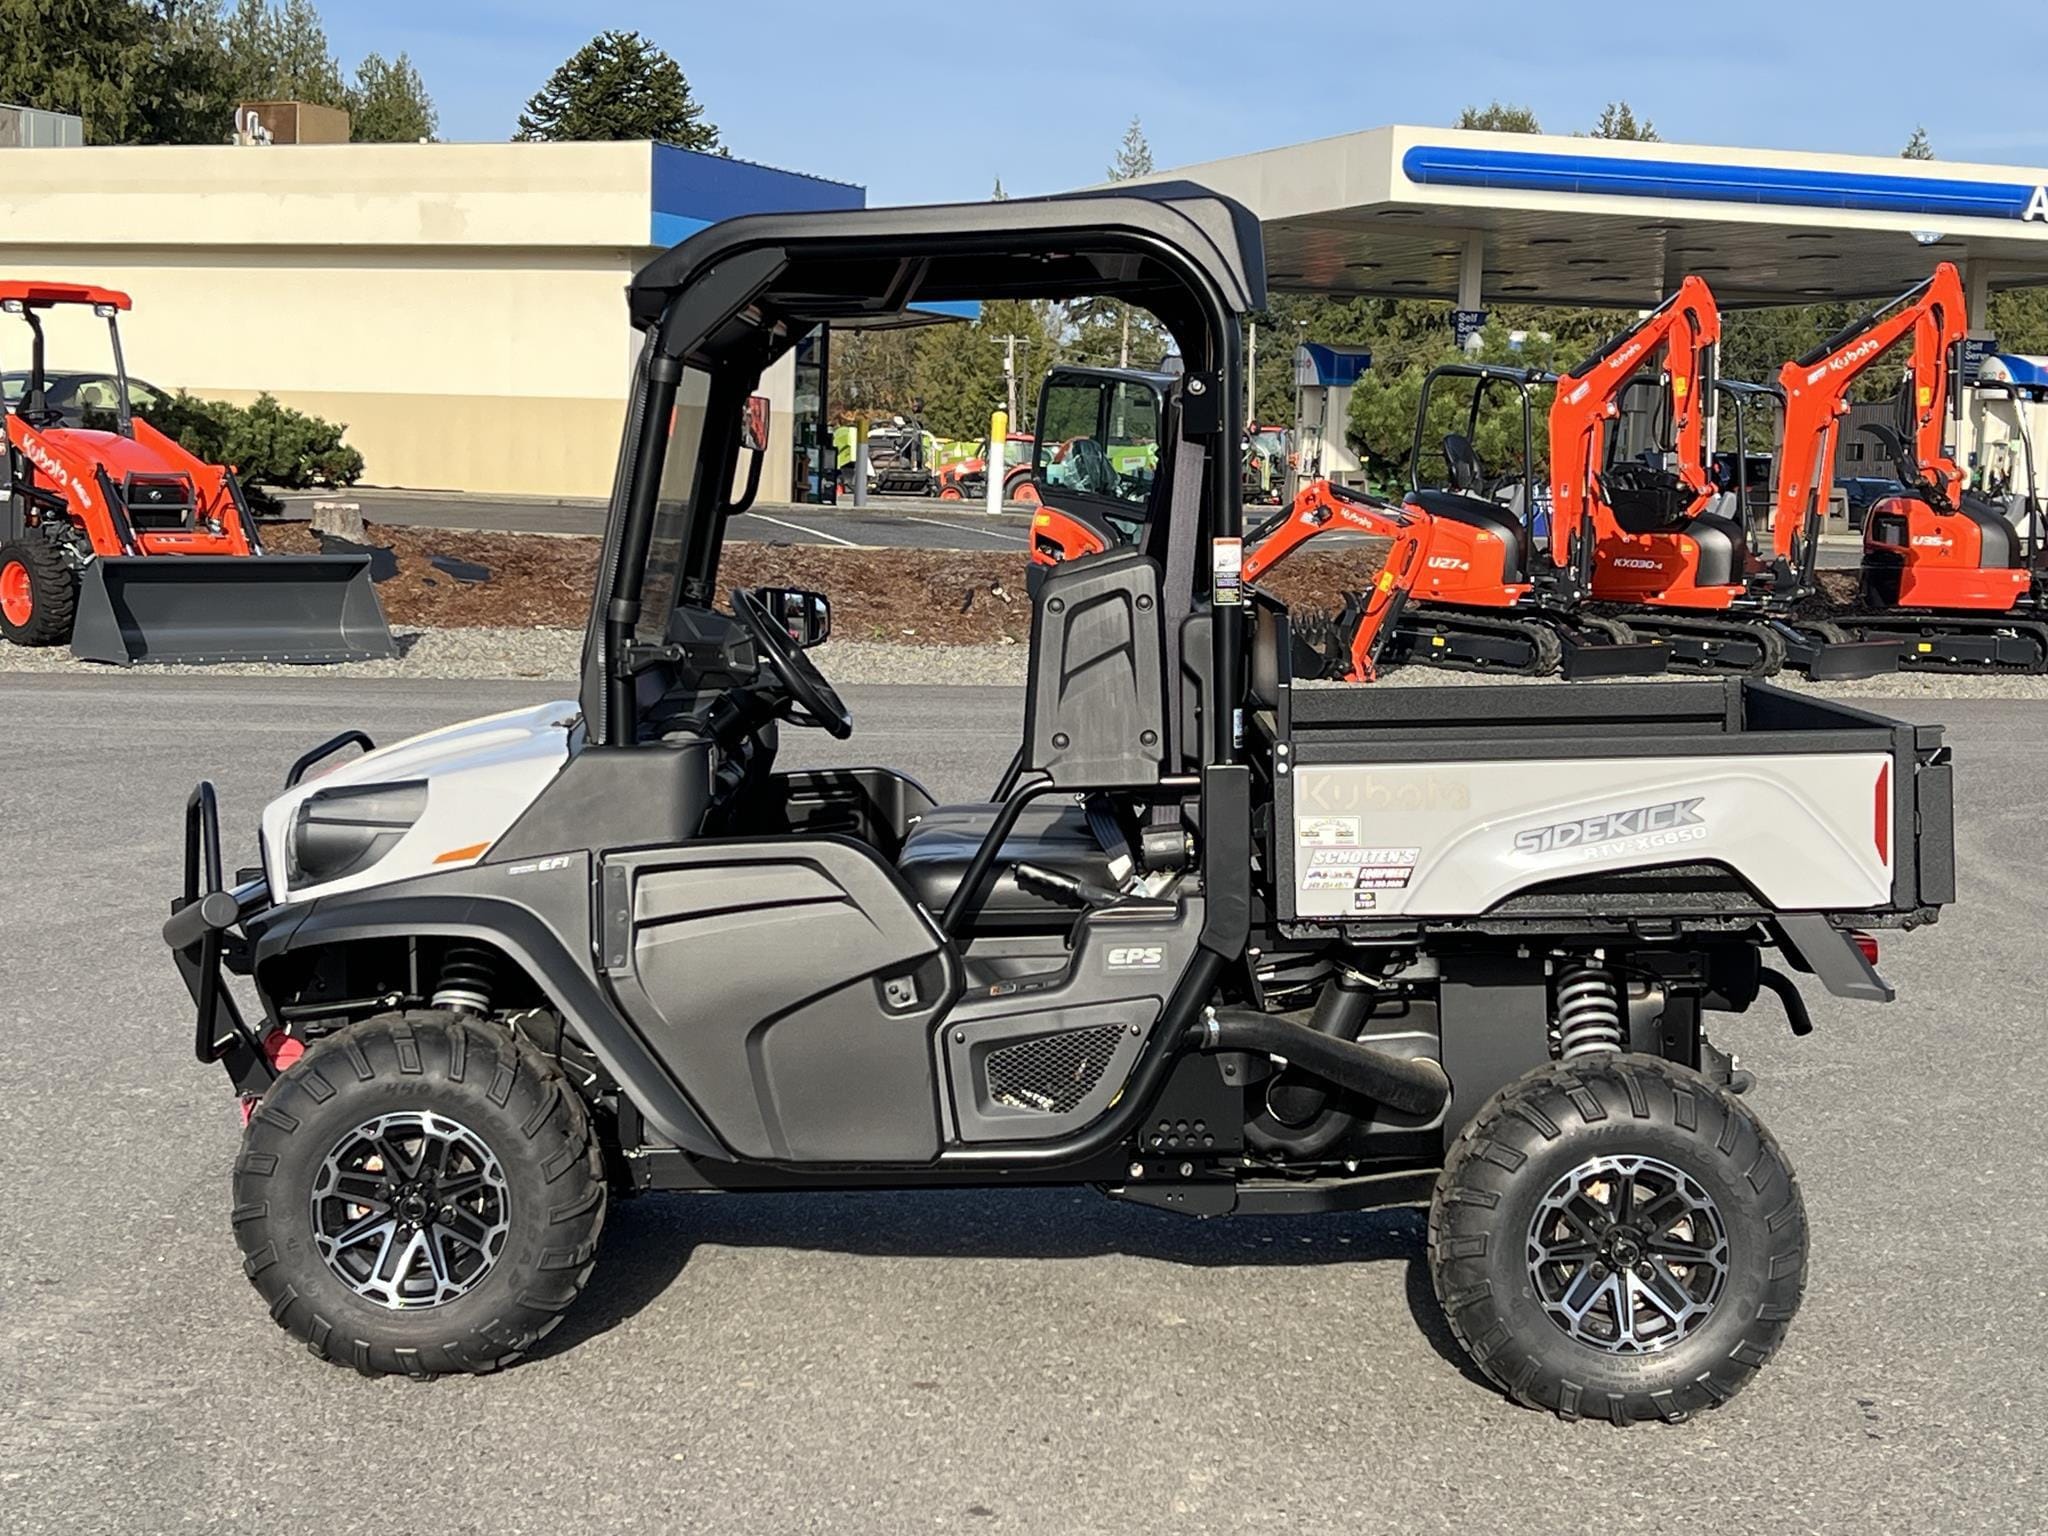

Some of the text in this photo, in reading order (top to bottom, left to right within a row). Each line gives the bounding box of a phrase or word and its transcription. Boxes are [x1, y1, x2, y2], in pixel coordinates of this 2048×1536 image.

[1458, 312, 1478, 323] Self
[1965, 341, 1983, 351] Self
[1608, 343, 1642, 368] Kubota
[1828, 339, 1880, 371] Kubota
[1965, 351, 1990, 360] Serv
[22, 433, 68, 486] Kubota
[1340, 508, 1373, 529] Kubota
[1428, 556, 1470, 571] U27-4
[1613, 558, 1663, 570] KX030-4
[1299, 774, 1472, 811] Kubota
[1514, 797, 1705, 855] SIDEKICK
[1582, 826, 1707, 860] RTV-XG850
[539, 856, 570, 872] EFI
[1312, 850, 1417, 865] SCHOLTEN'S
[1355, 900, 1376, 909] STEP
[1108, 947, 1163, 965] EPS
